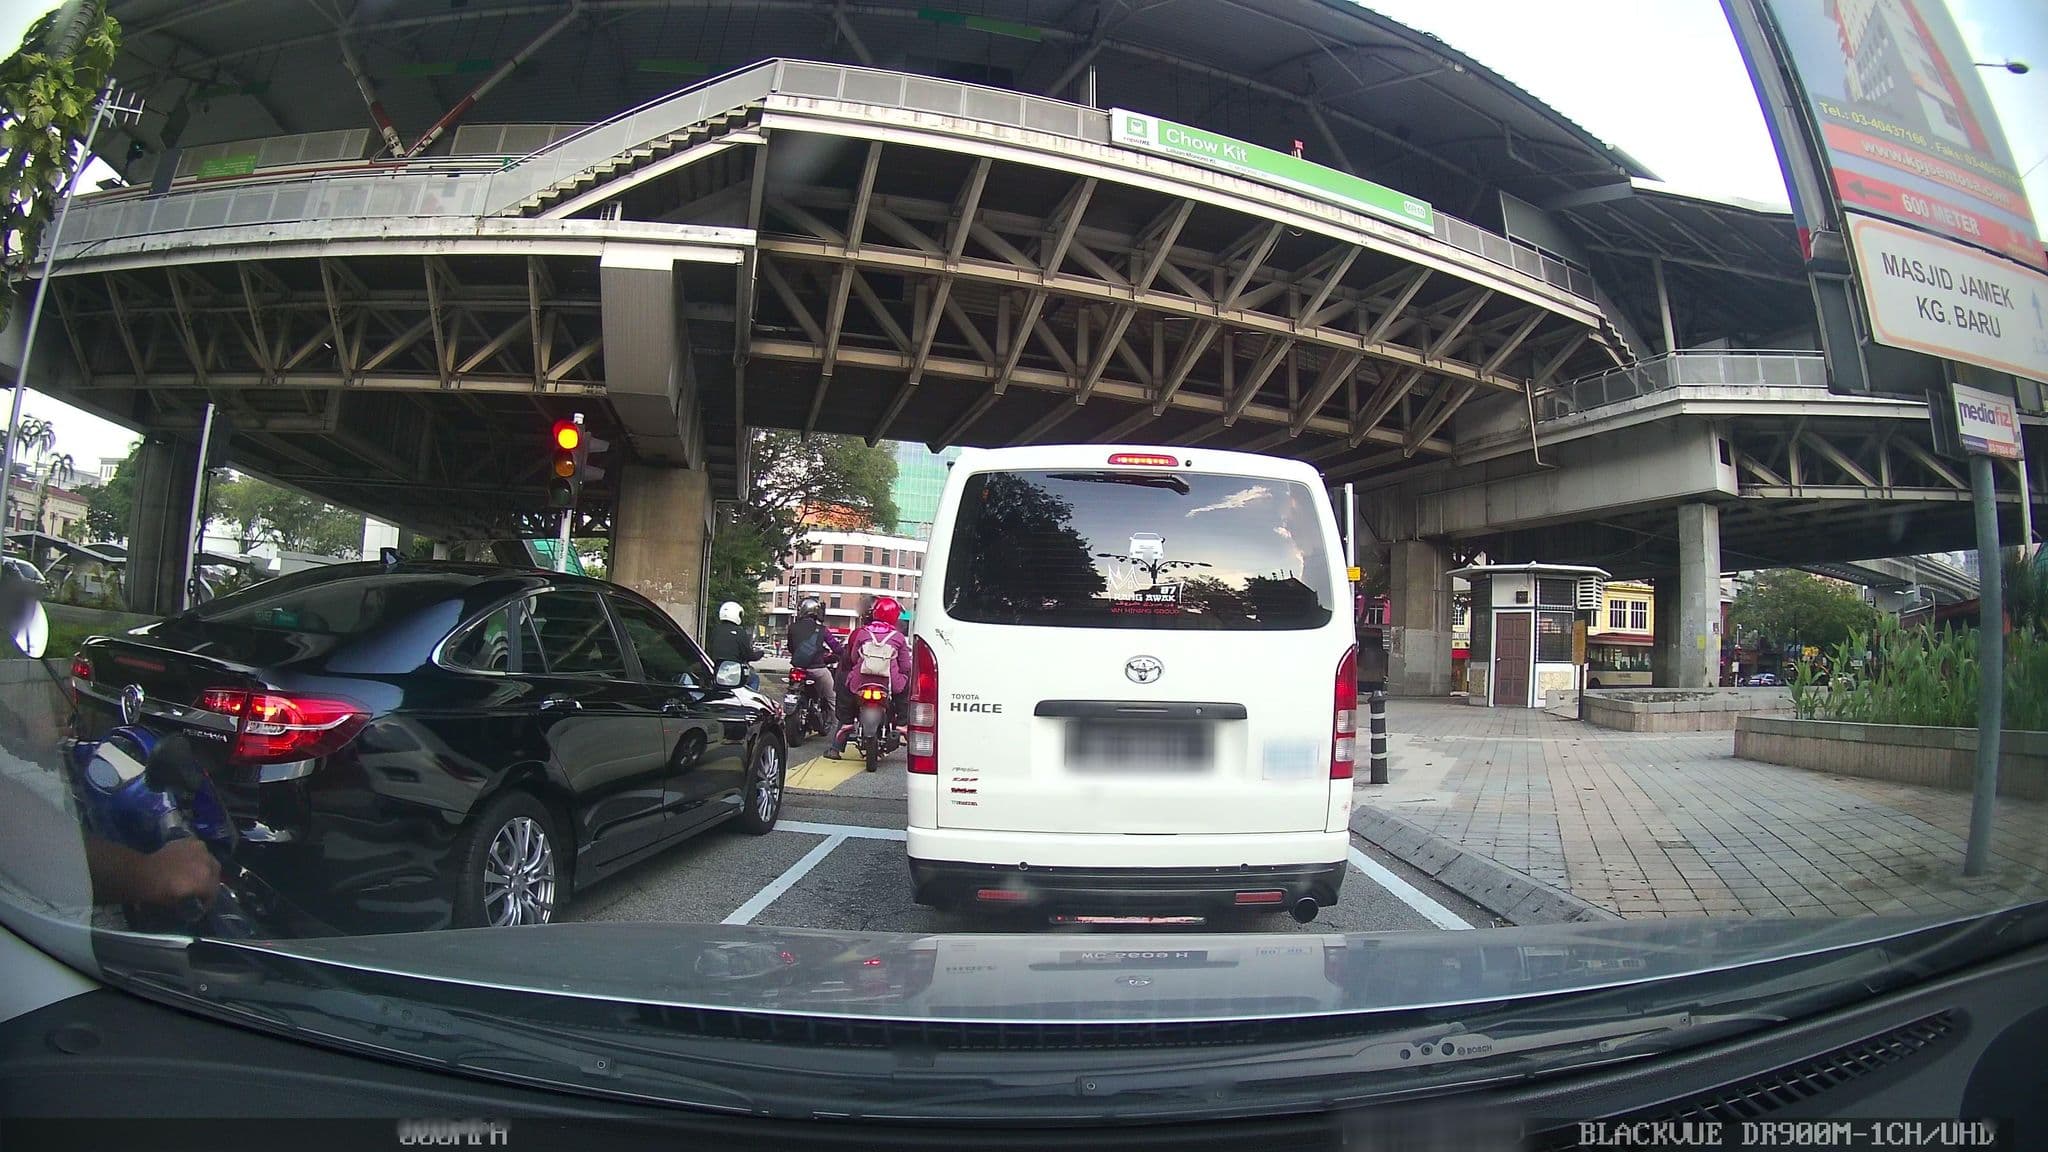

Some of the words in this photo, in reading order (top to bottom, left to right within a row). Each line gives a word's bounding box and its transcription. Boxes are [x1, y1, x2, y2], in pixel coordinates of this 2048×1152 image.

[1166, 128, 1218, 154] Chow
[1222, 142, 1248, 163] Kit
[1901, 193, 1930, 218] 600
[1931, 203, 1981, 237] METER
[1881, 252, 1953, 290] MASJID
[1959, 274, 2015, 310] JAMEK
[1916, 296, 1951, 325] KG.
[1953, 305, 2001, 338] BARU
[1958, 402, 2013, 428] mediafiz
[1146, 594, 1176, 602] AWAK
[950, 702, 1002, 713] HIACE
[1466, 1045, 1493, 1055] BOSCH
